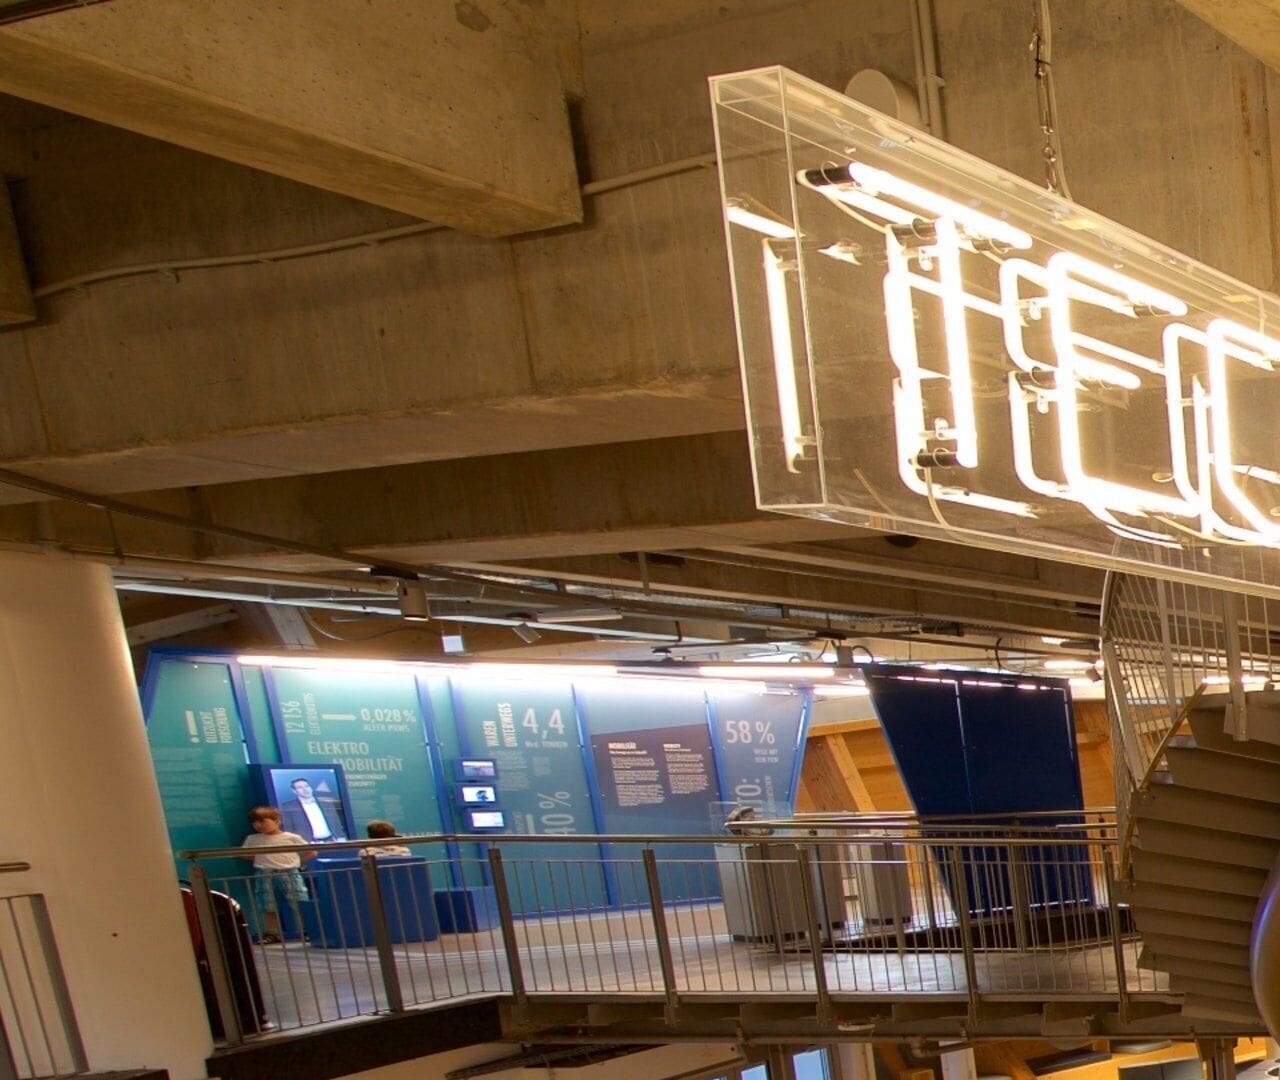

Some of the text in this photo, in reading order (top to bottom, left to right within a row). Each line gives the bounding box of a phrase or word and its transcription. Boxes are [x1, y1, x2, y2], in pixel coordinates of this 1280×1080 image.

[498, 702, 518, 748] UNTERWEGS
[522, 708, 565, 739] 4,4
[725, 720, 752, 743] 58
[307, 741, 369, 755] ELEKTRO
